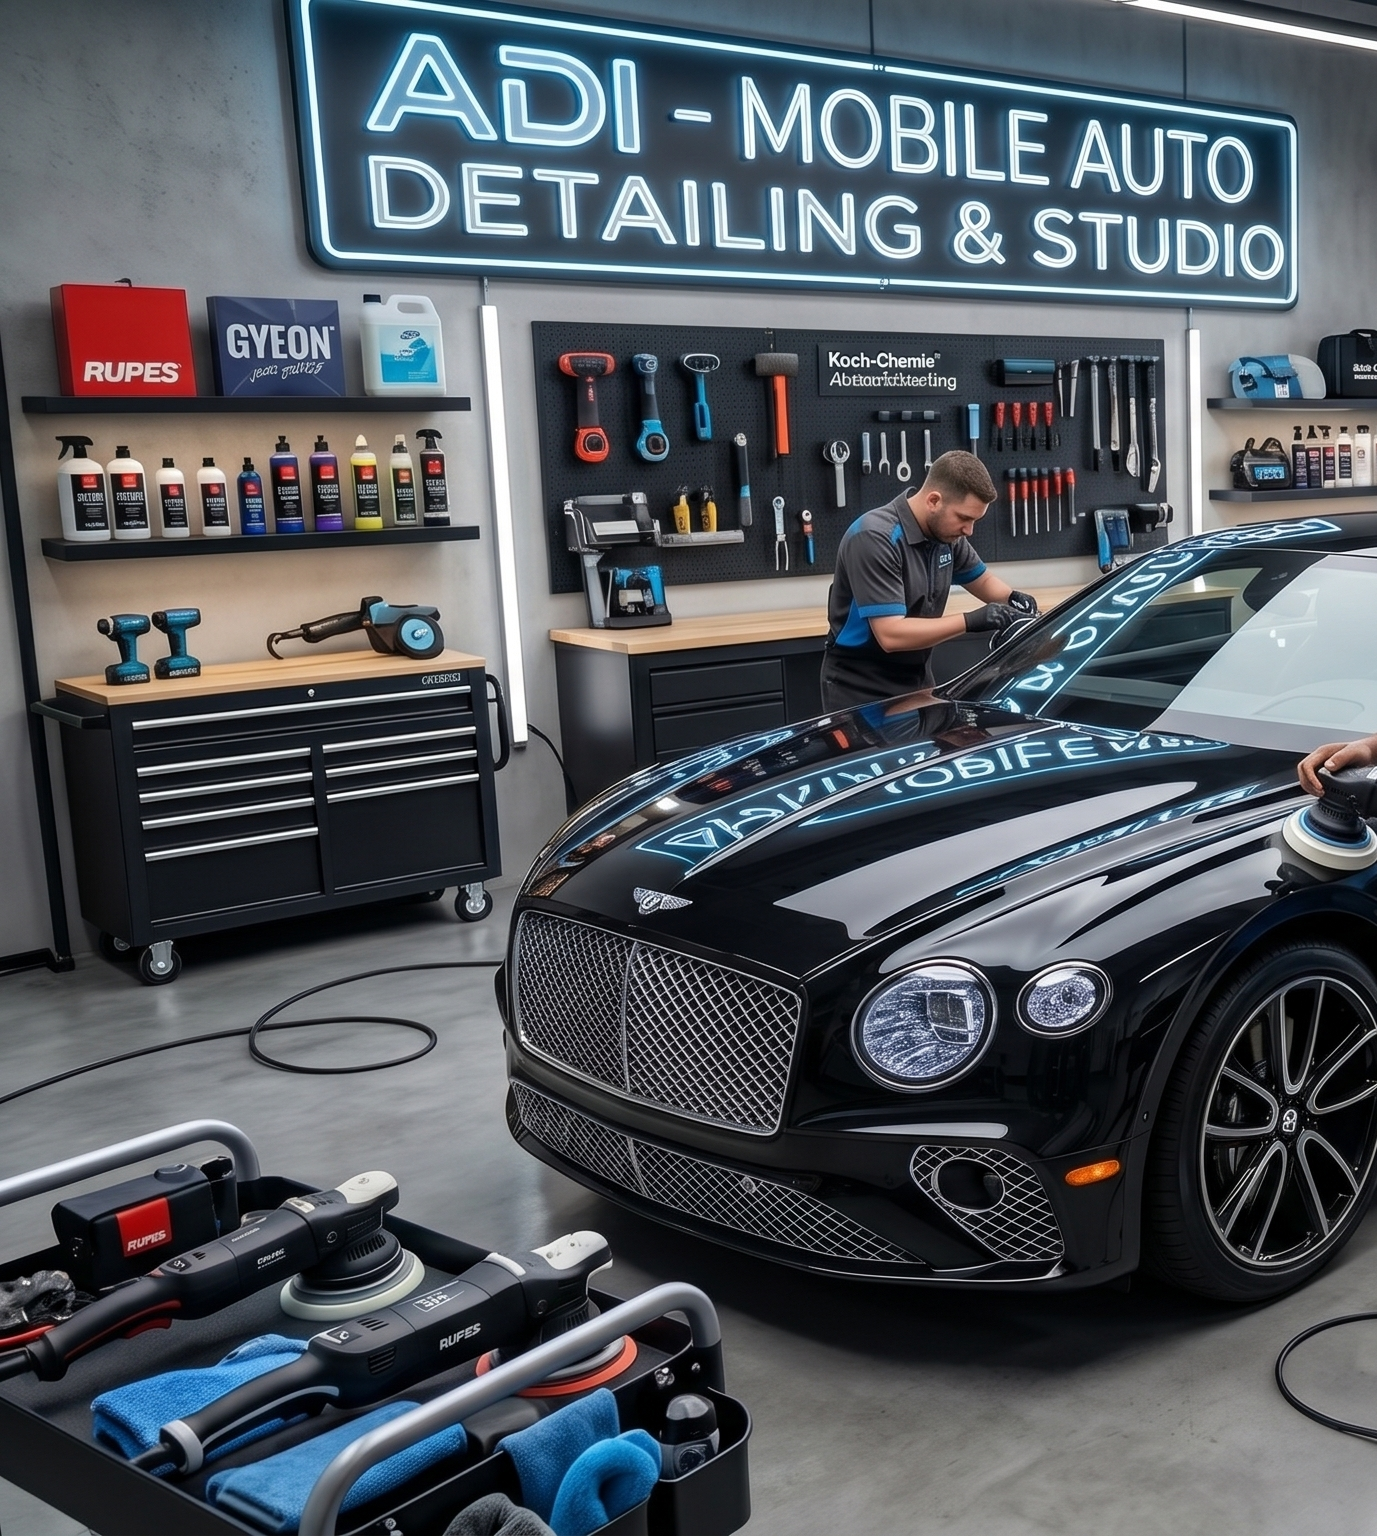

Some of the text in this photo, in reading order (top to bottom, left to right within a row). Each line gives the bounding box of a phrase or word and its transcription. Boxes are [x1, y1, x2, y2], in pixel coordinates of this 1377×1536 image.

[366, 32, 641, 154] ADI
[741, 76, 1050, 187] MOBILE
[1070, 119, 1254, 205] AUTO
[368, 155, 1286, 281] DETAILING & STUDIO
[83, 361, 180, 383] RUPES
[226, 323, 332, 360] GYEON
